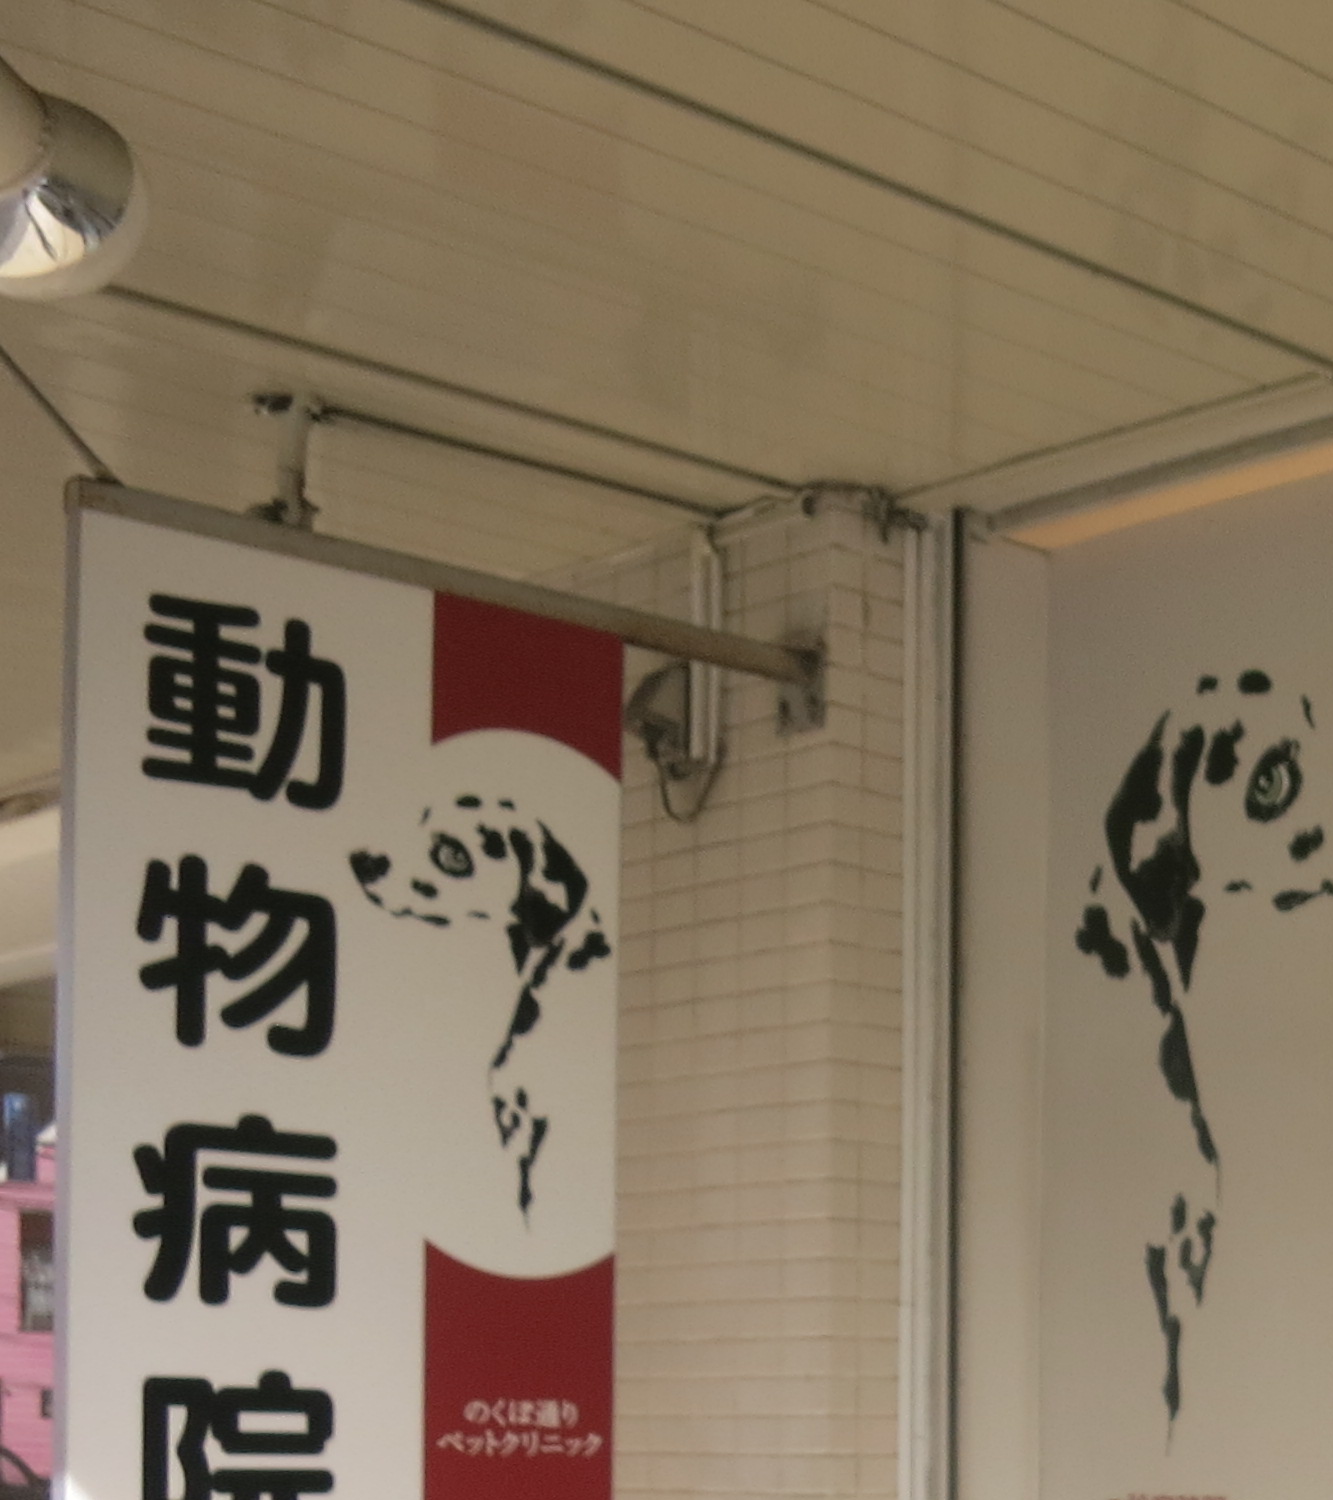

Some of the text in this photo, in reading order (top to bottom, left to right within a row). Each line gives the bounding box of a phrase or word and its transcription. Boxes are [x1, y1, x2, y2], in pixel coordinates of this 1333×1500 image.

[463, 1398, 579, 1429] のくぼ通り
[436, 1429, 604, 1458] ペットクリニック
